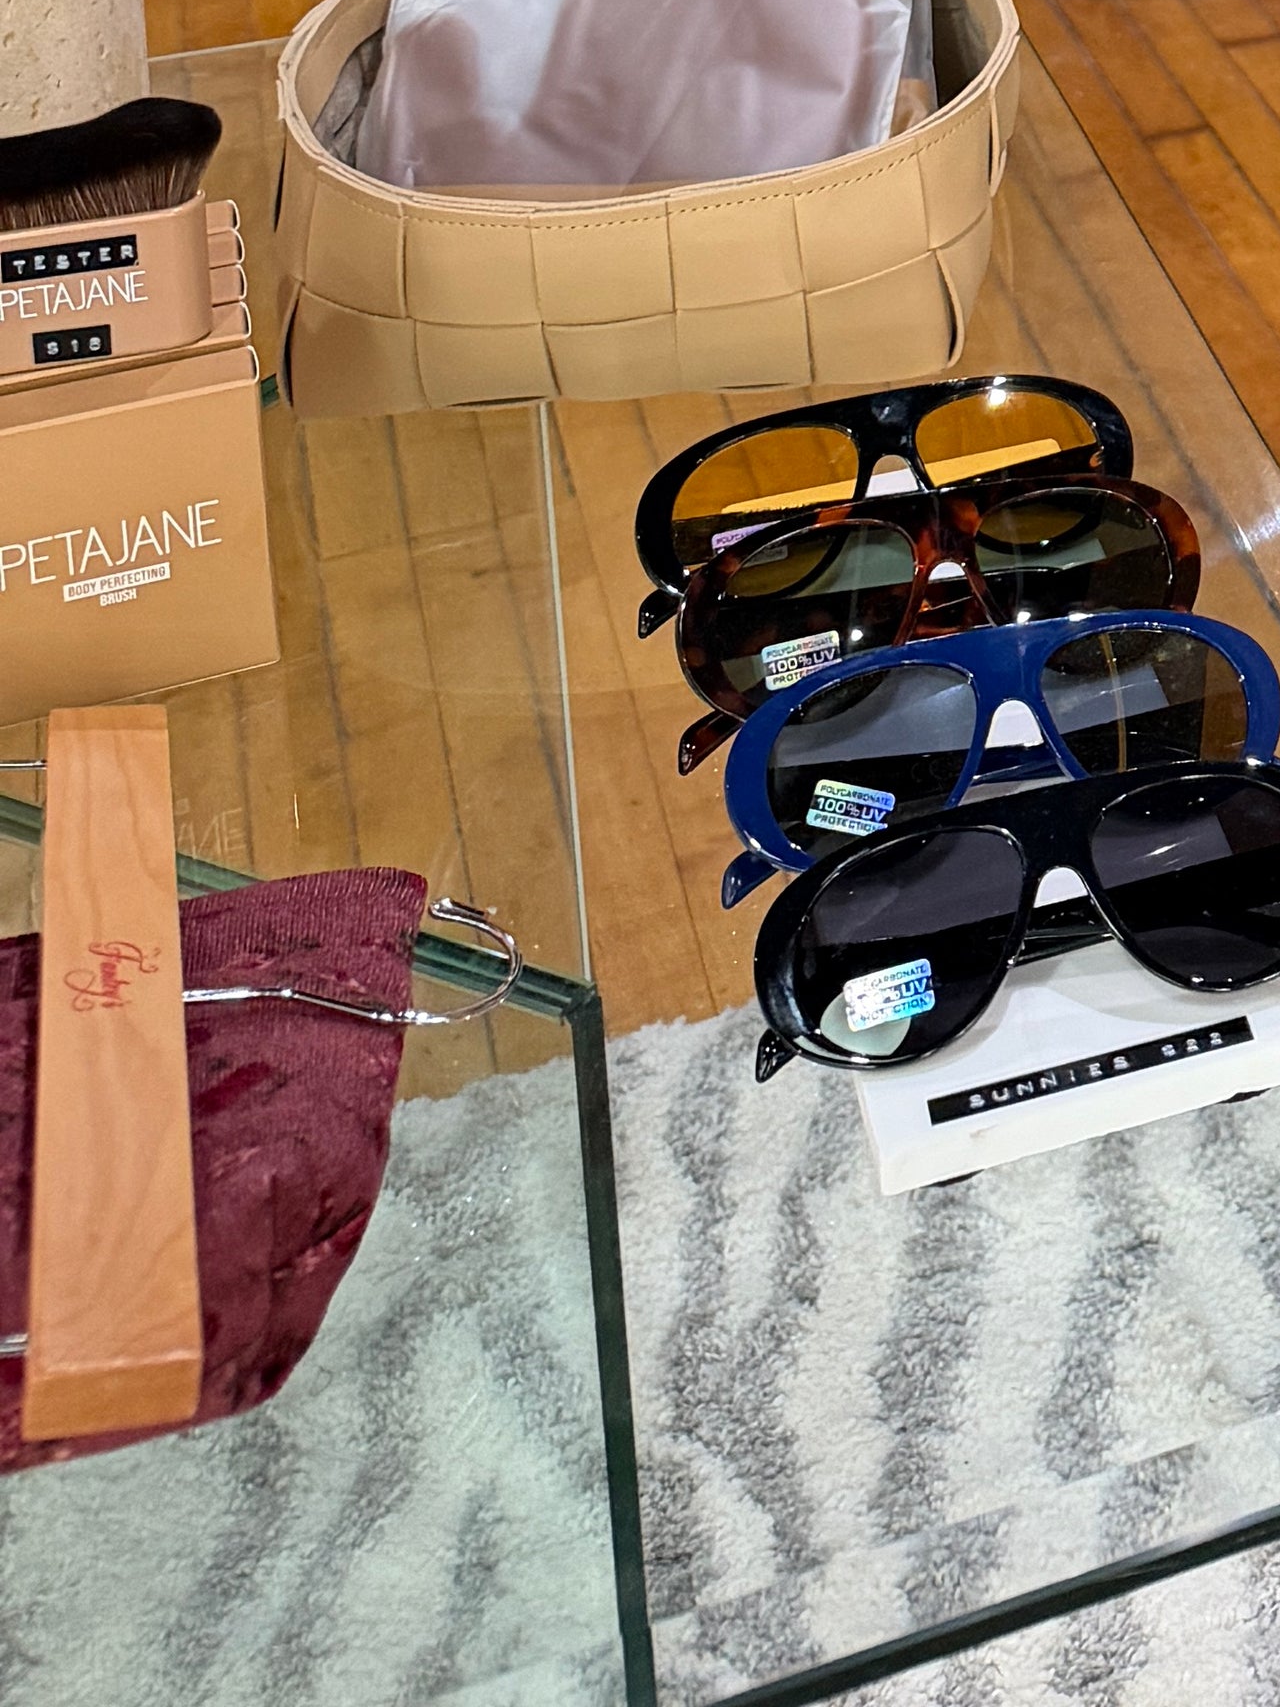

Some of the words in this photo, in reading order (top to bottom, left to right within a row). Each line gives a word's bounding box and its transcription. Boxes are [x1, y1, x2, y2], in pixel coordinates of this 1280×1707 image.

[13, 244, 135, 275] TESTER
[0, 270, 149, 322] PETAJANE
[0, 498, 223, 592] PETAJANE
[67, 579, 98, 599] BODY
[99, 565, 166, 592] PERFECTING
[99, 588, 137, 607] BRUSH
[968, 1054, 1131, 1109] SUNNIES
